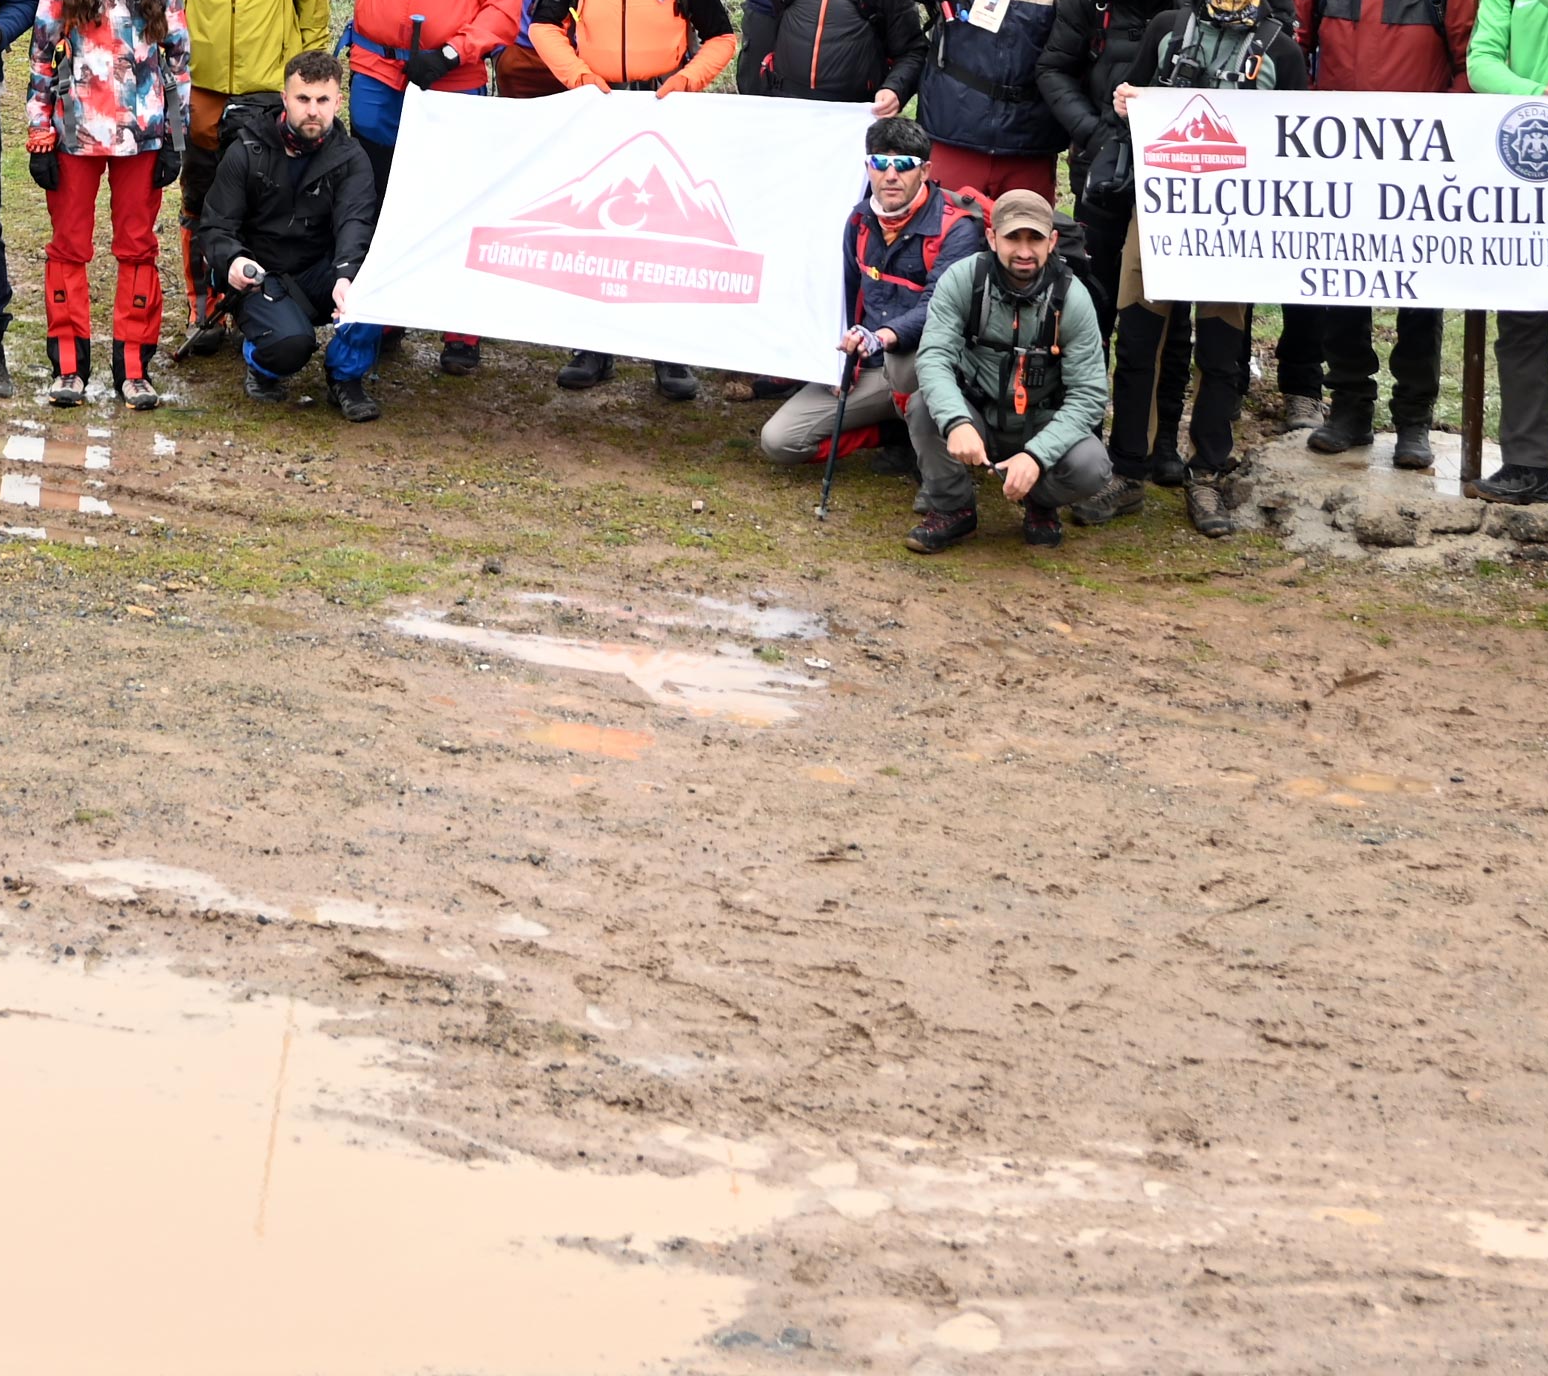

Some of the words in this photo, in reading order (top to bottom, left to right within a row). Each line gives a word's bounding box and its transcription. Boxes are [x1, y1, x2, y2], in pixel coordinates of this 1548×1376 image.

[1275, 114, 1456, 163] KONYA
[1144, 176, 1353, 226] SELÇUKLU
[478, 241, 548, 270] TÜRKİYE
[551, 248, 628, 281] DAĞCILIK
[632, 260, 755, 295] FEDERASYONU
[1150, 234, 1172, 256] ve
[1178, 227, 1265, 259] ARAMA
[1271, 230, 1405, 263] KURTARMA
[1412, 234, 1474, 266] SPOR
[600, 281, 628, 298] 1936
[1300, 267, 1419, 300] SEDAK
